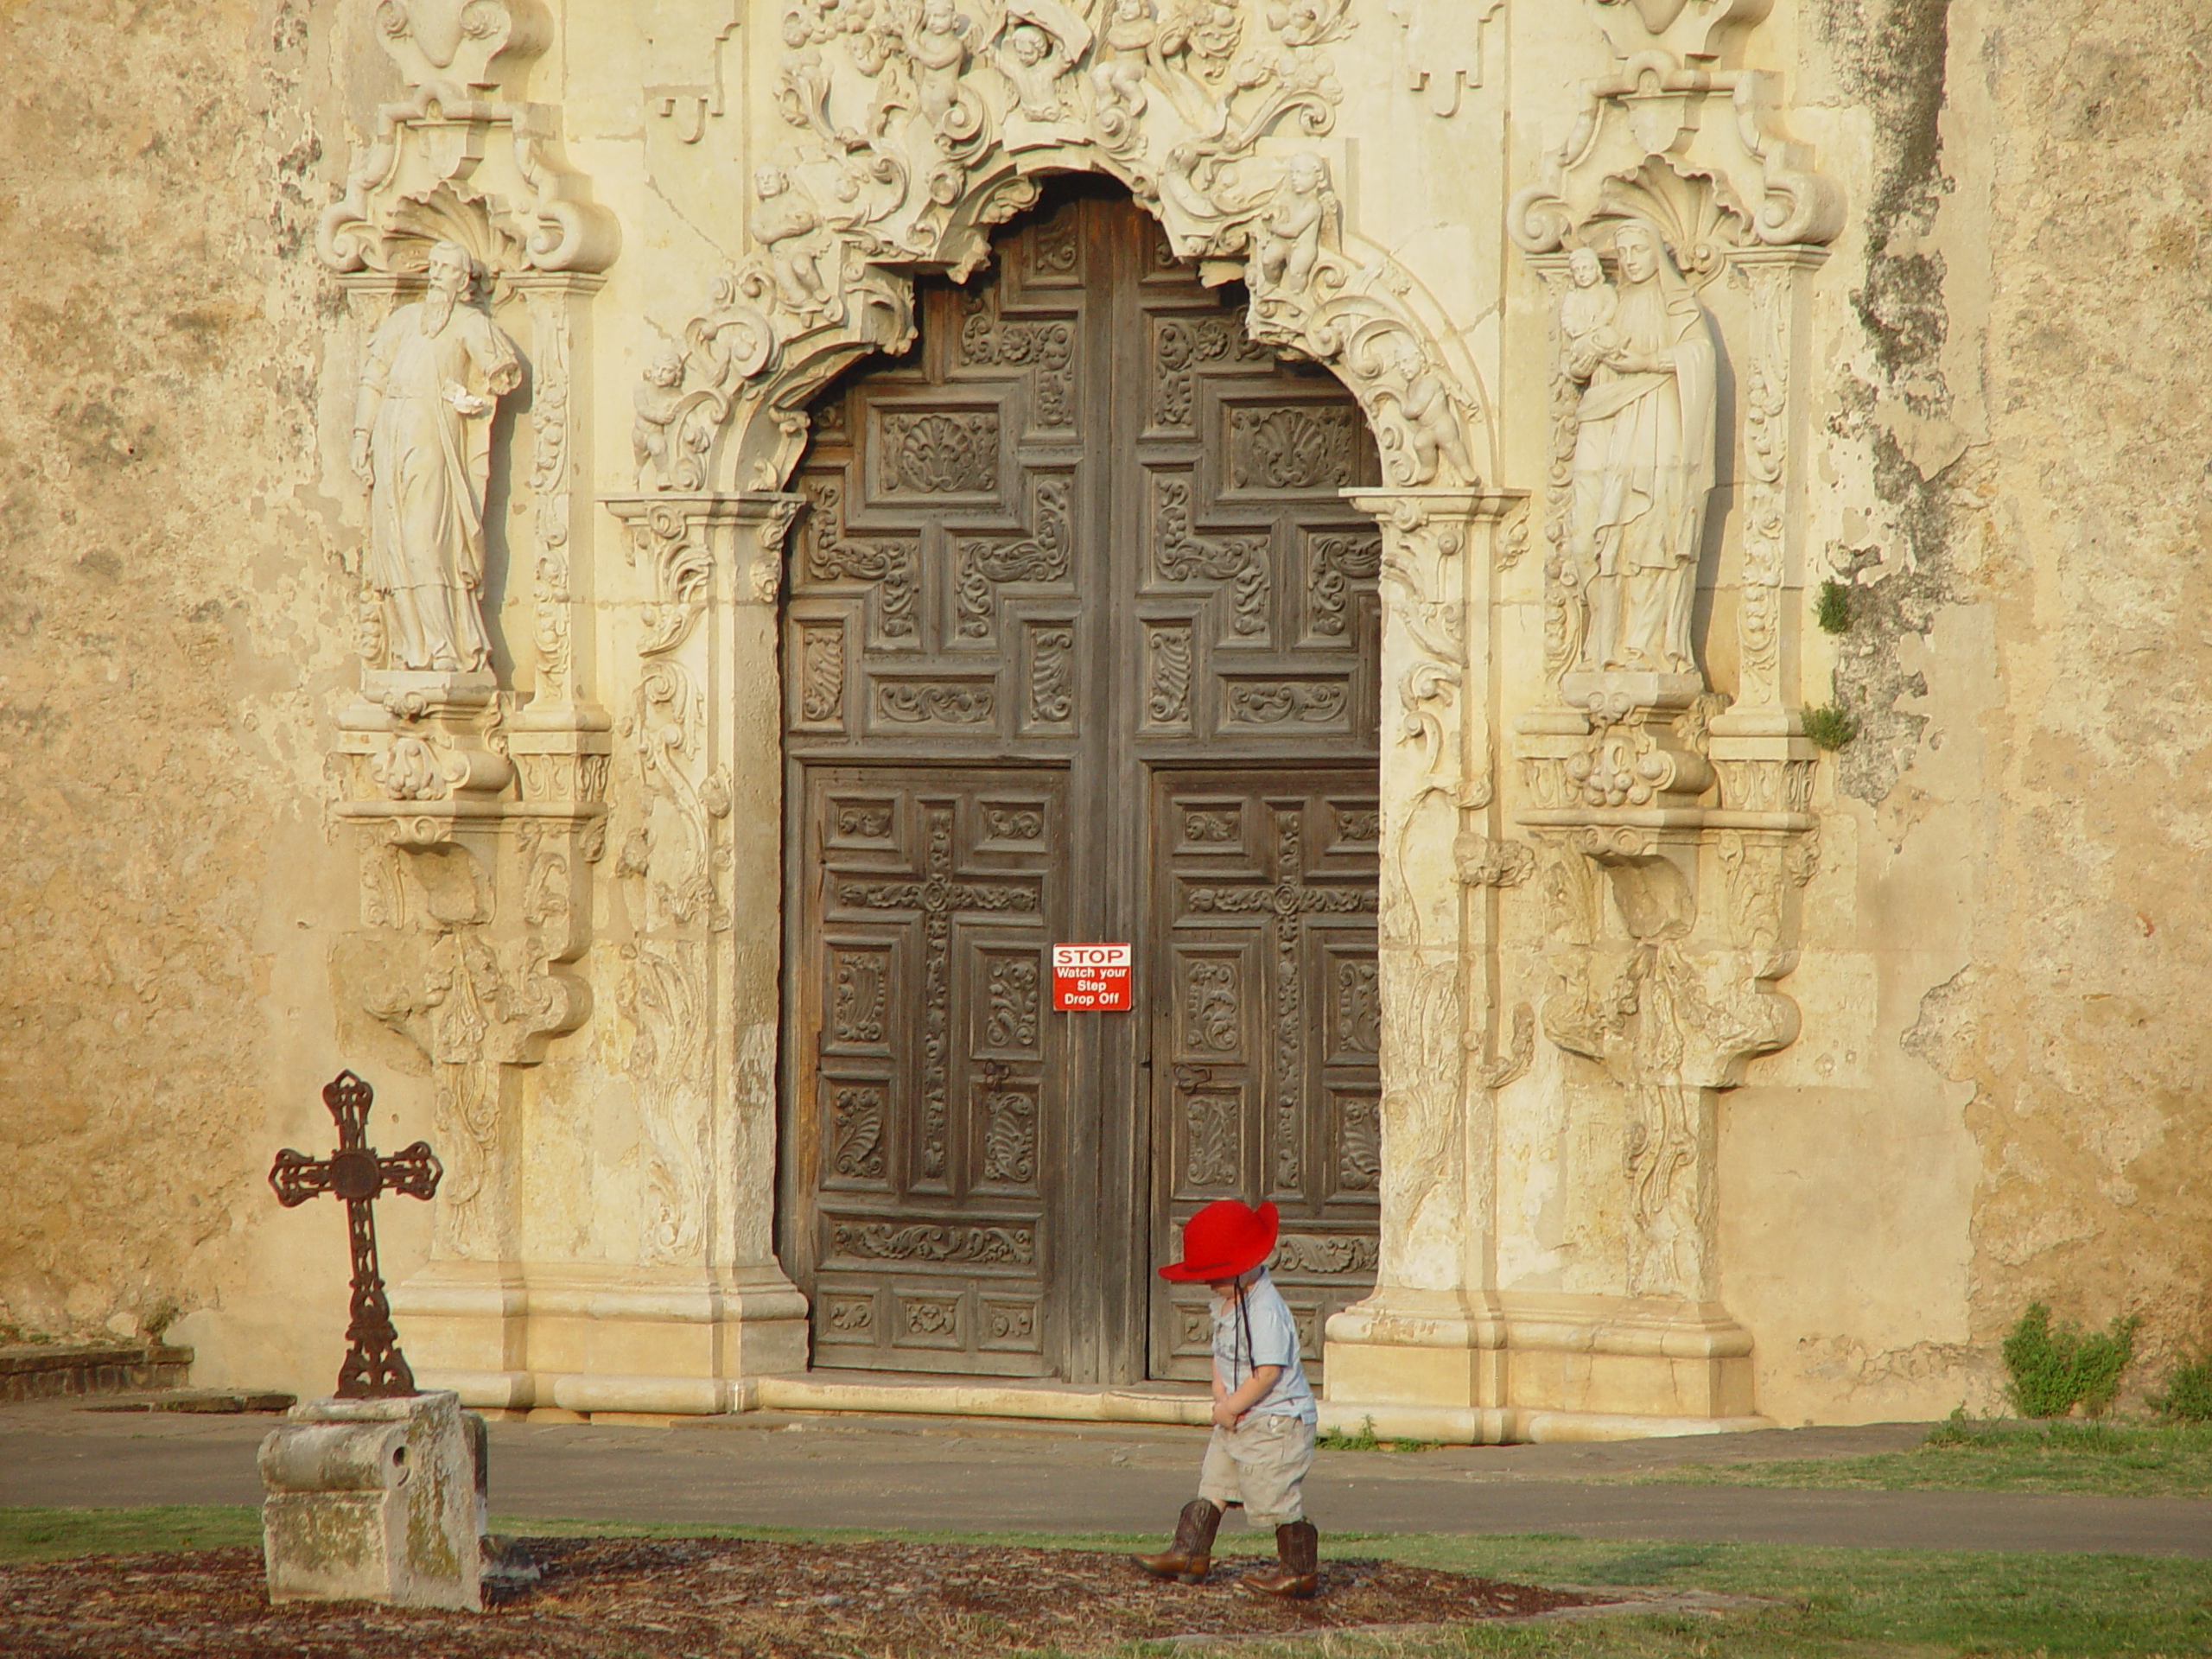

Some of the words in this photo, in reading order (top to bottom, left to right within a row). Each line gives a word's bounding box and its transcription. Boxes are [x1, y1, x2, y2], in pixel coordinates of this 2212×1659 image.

[1058, 950, 1123, 963] STOP
[1057, 967, 1095, 978] Watch
[1100, 968, 1127, 980] your
[1077, 980, 1107, 993] Step
[1065, 993, 1095, 1006] Drop
[1099, 992, 1119, 1004] Off
